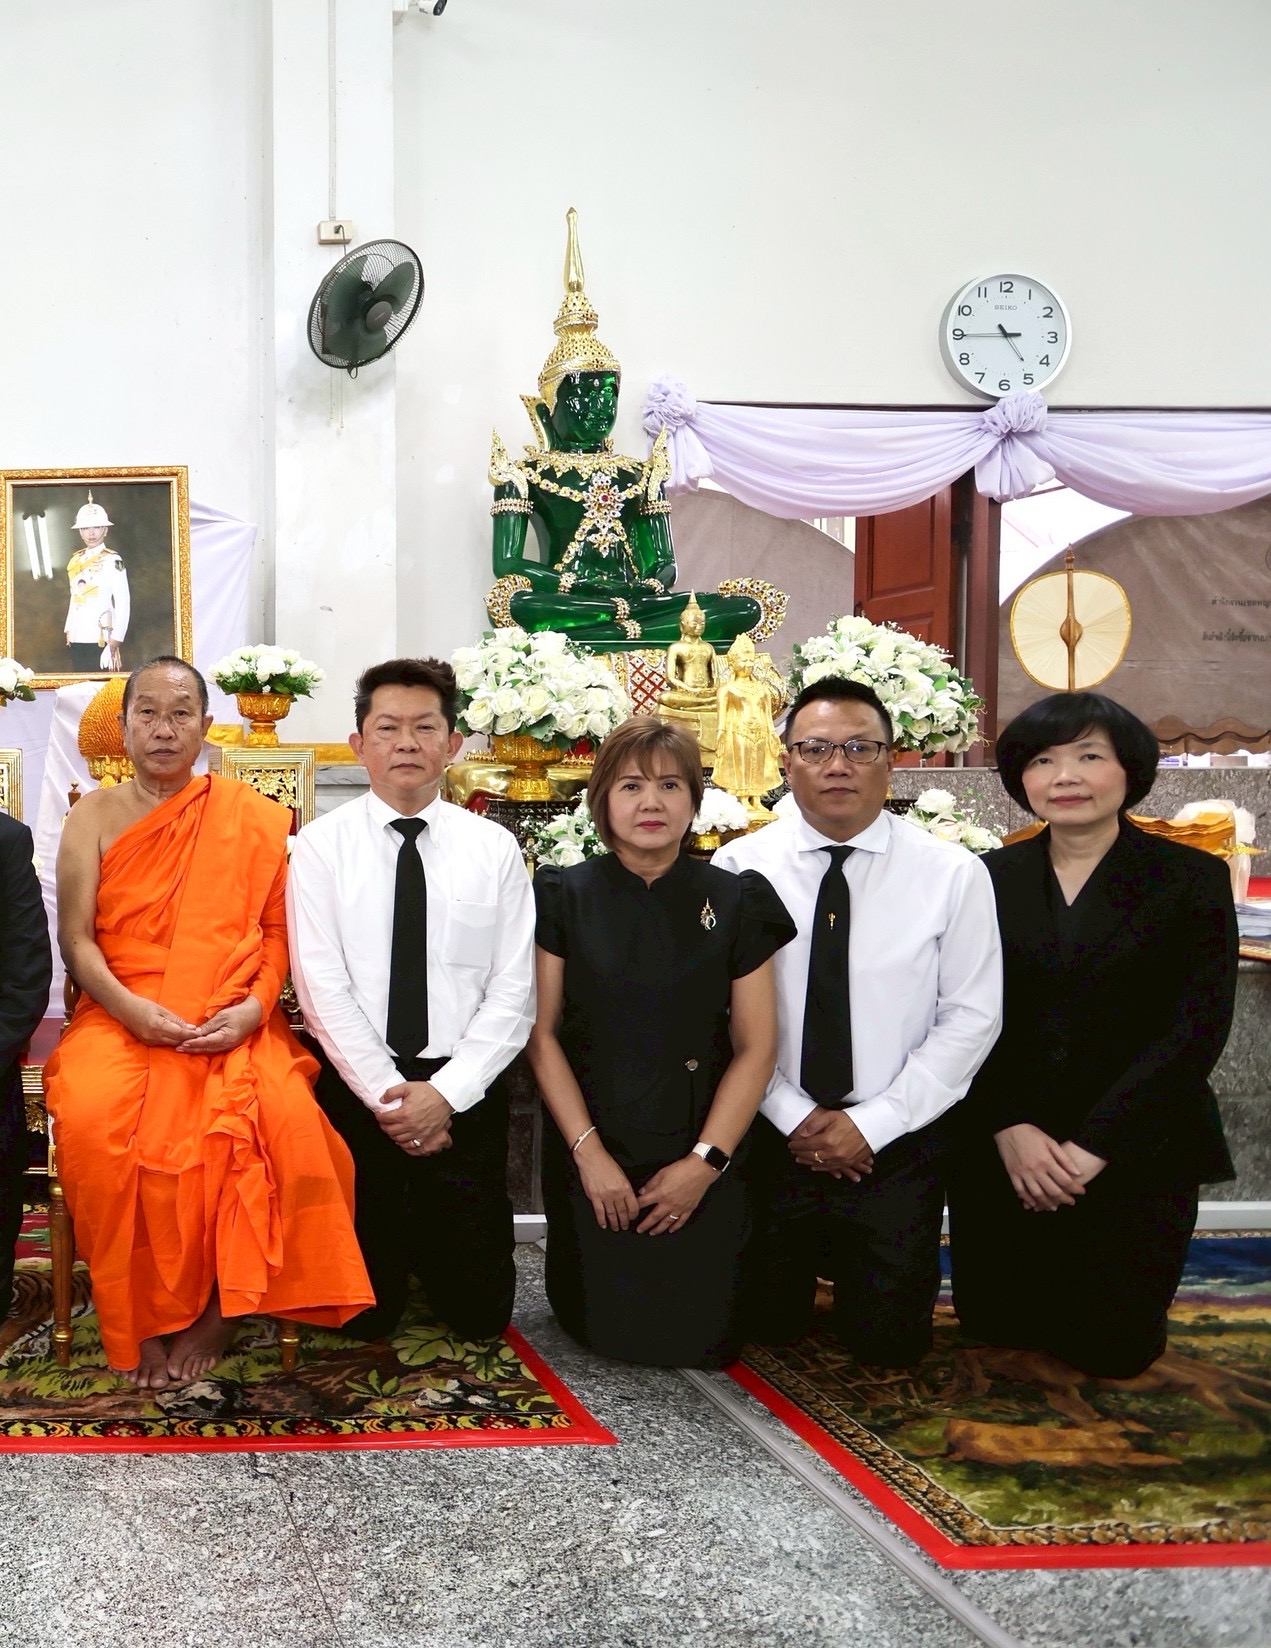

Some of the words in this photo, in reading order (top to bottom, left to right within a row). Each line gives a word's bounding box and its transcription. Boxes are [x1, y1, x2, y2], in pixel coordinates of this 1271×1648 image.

[978, 286, 987, 298] 11
[999, 281, 1014, 293] 12
[1028, 289, 1032, 300] 1
[958, 304, 972, 316] 10
[1042, 306, 1053, 318] 2
[952, 328, 965, 340] 9
[1047, 331, 1058, 343] 3
[959, 352, 970, 365] 8
[1039, 354, 1050, 367] 4
[974, 372, 985, 384] 7
[1023, 373, 1034, 385] 5
[998, 380, 1010, 391] 6
